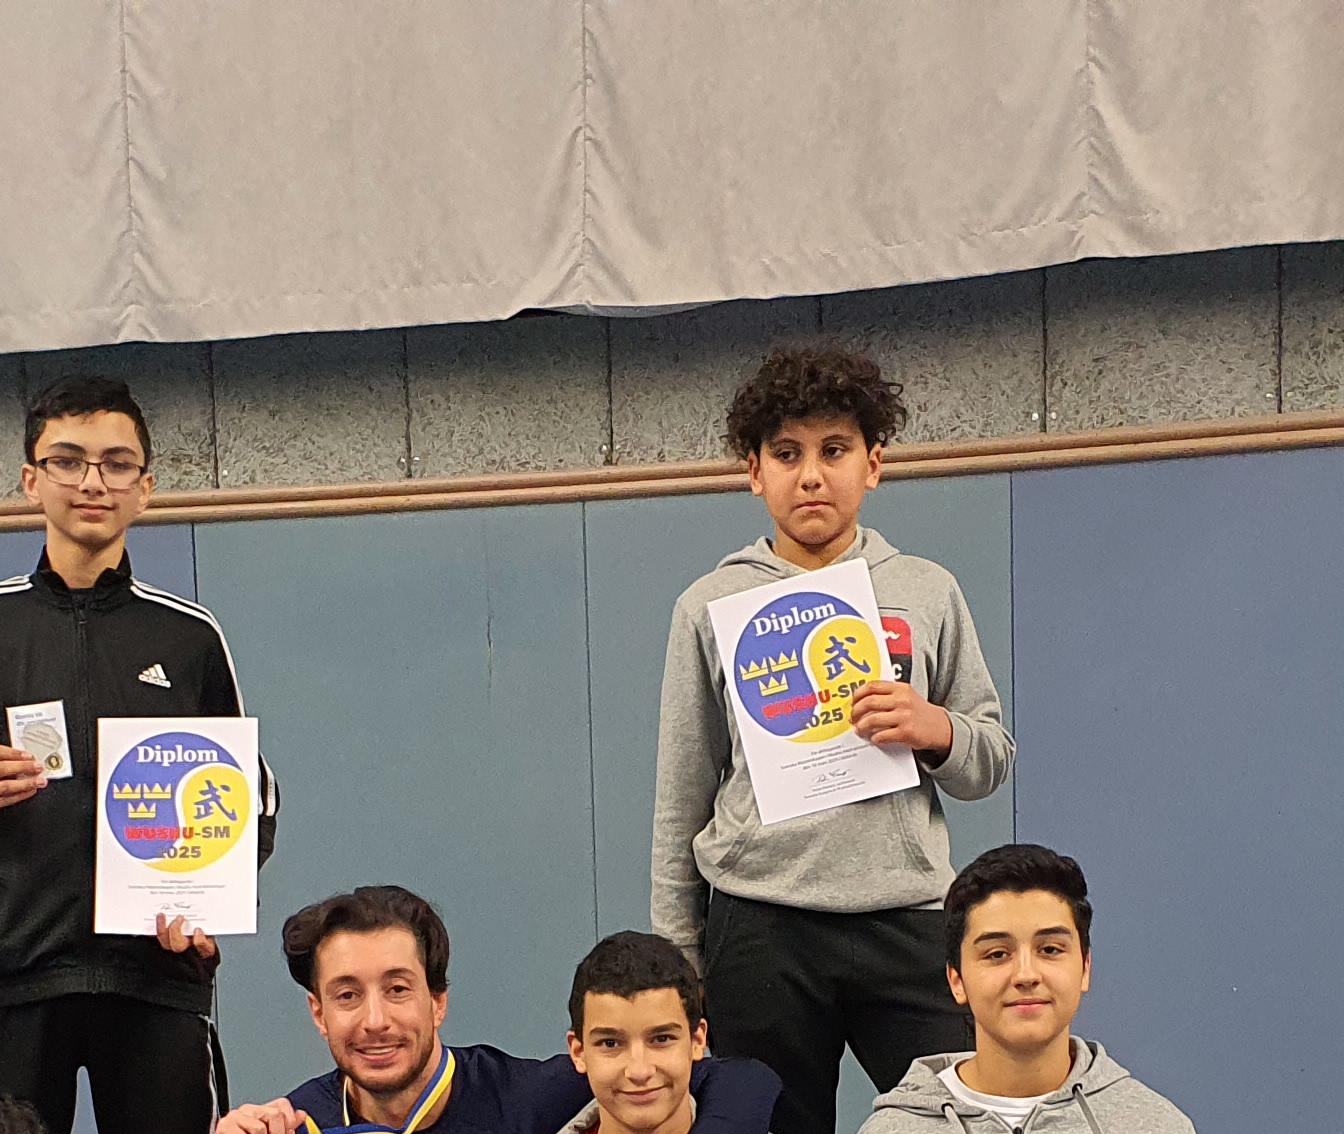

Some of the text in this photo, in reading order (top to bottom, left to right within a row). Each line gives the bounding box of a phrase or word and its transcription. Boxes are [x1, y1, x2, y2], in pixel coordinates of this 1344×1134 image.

[753, 603, 836, 636] Diplom
[823, 636, 871, 681] 武
[137, 745, 219, 766] Diplom
[193, 780, 238, 821] 武
